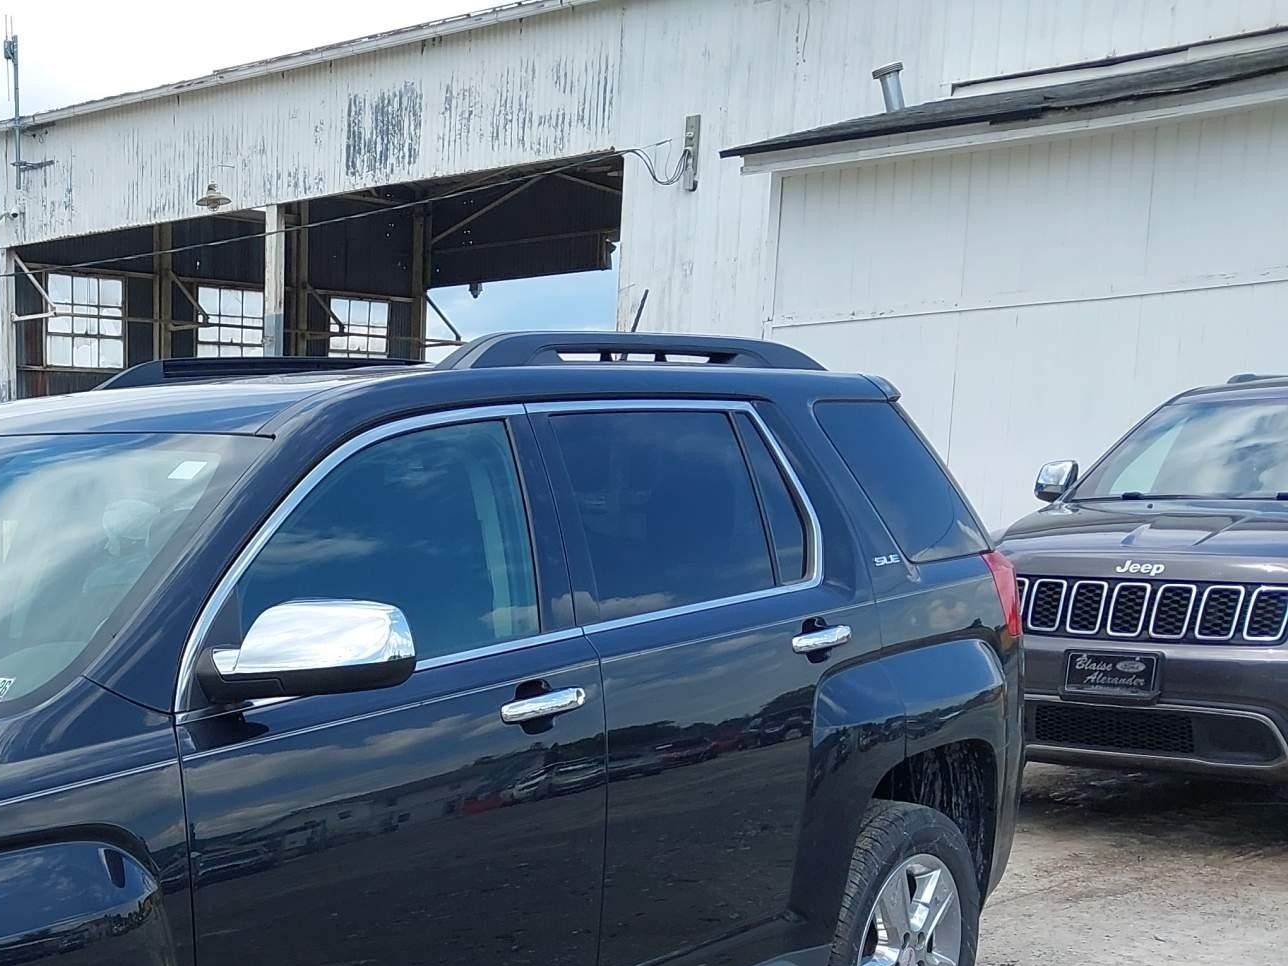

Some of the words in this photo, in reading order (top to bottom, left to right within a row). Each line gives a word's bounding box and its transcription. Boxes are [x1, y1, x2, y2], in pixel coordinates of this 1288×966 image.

[874, 554, 901, 566] SLE
[1115, 560, 1165, 577] Jeep
[1075, 656, 1113, 671] Blaise
[1083, 671, 1145, 686] Alexander
